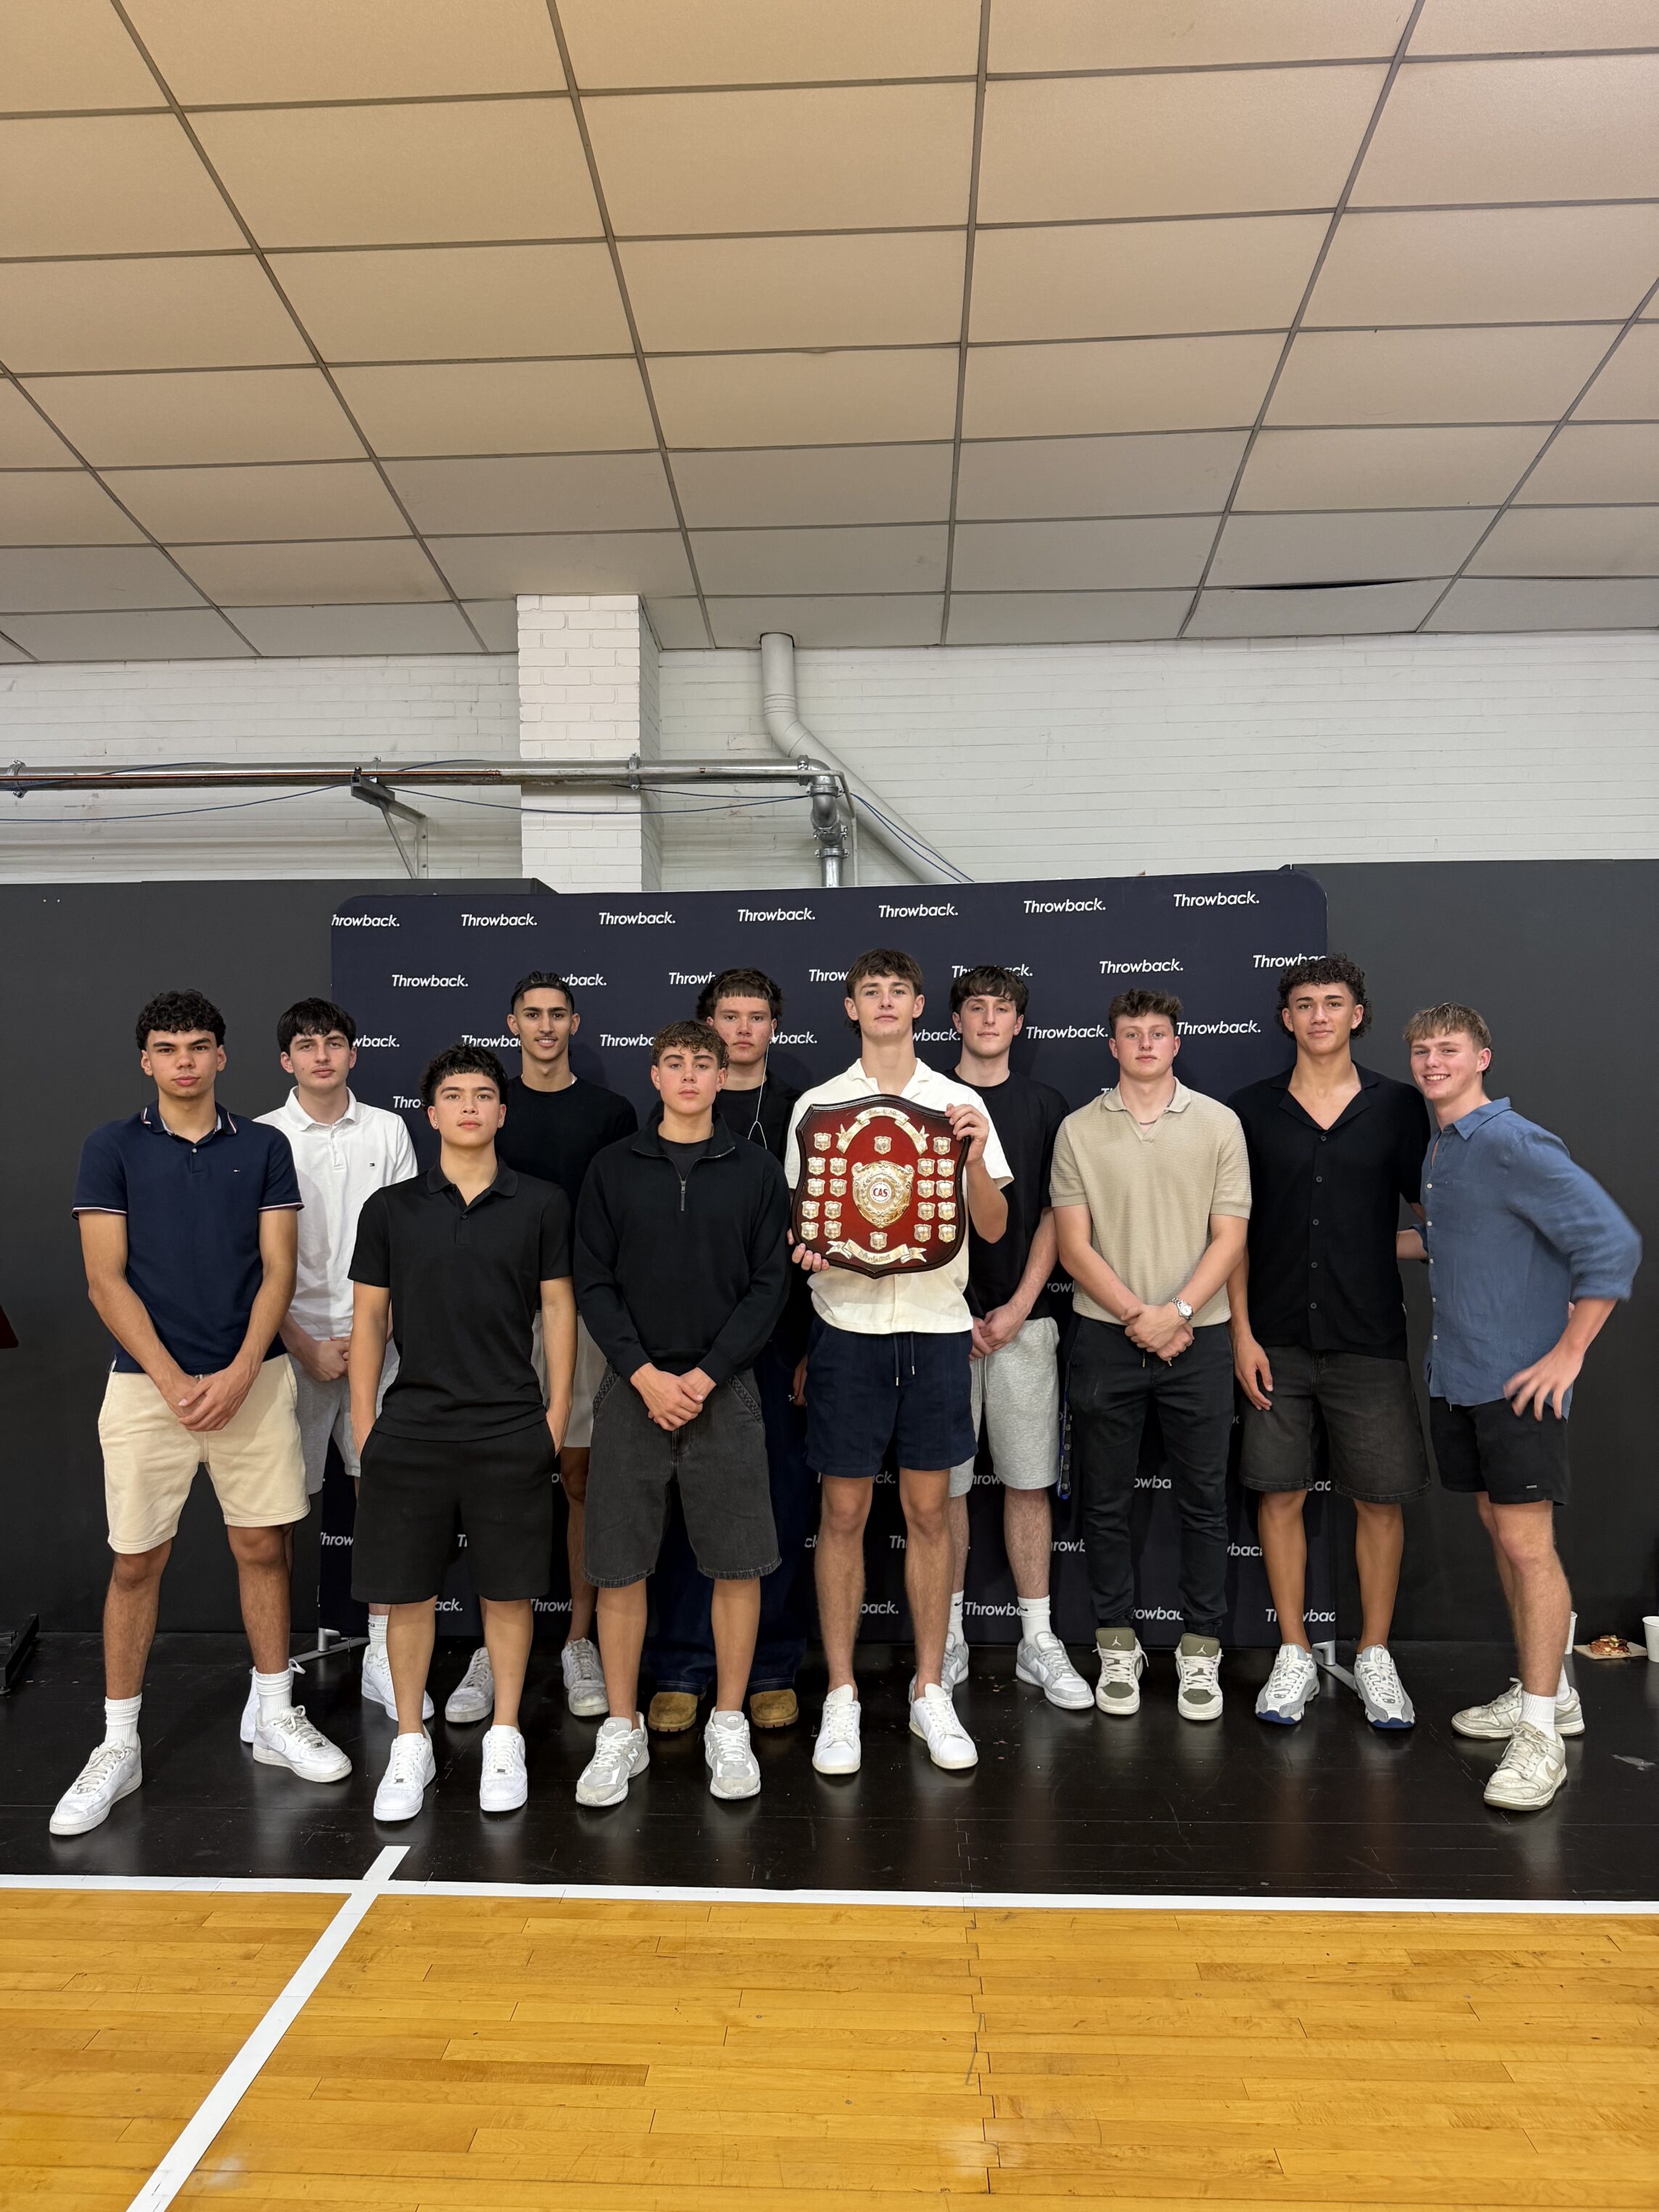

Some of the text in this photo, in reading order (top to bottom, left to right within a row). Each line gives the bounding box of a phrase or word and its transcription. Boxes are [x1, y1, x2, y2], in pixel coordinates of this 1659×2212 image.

[1173, 891, 1259, 906] Throwback.
[879, 904, 958, 917] Throwback.
[1024, 898, 1106, 913] Throwback.
[332, 914, 399, 927] hrowback.
[462, 914, 537, 926] Throwback.
[599, 912, 676, 925] Throwback.
[738, 908, 815, 922] Throwback.
[1099, 959, 1184, 974] Throwback.
[392, 975, 468, 987] Throwback.
[560, 973, 607, 986] wback.
[668, 972, 716, 985] Throwb
[809, 969, 849, 982] Throw
[1026, 1025, 1108, 1040] Throwback.
[1176, 1020, 1261, 1035] Throwback.
[353, 1035, 400, 1047] wback.
[461, 1035, 520, 1047] Throwba
[912, 1028, 961, 1041] wback.
[873, 1188, 888, 1197] CAS
